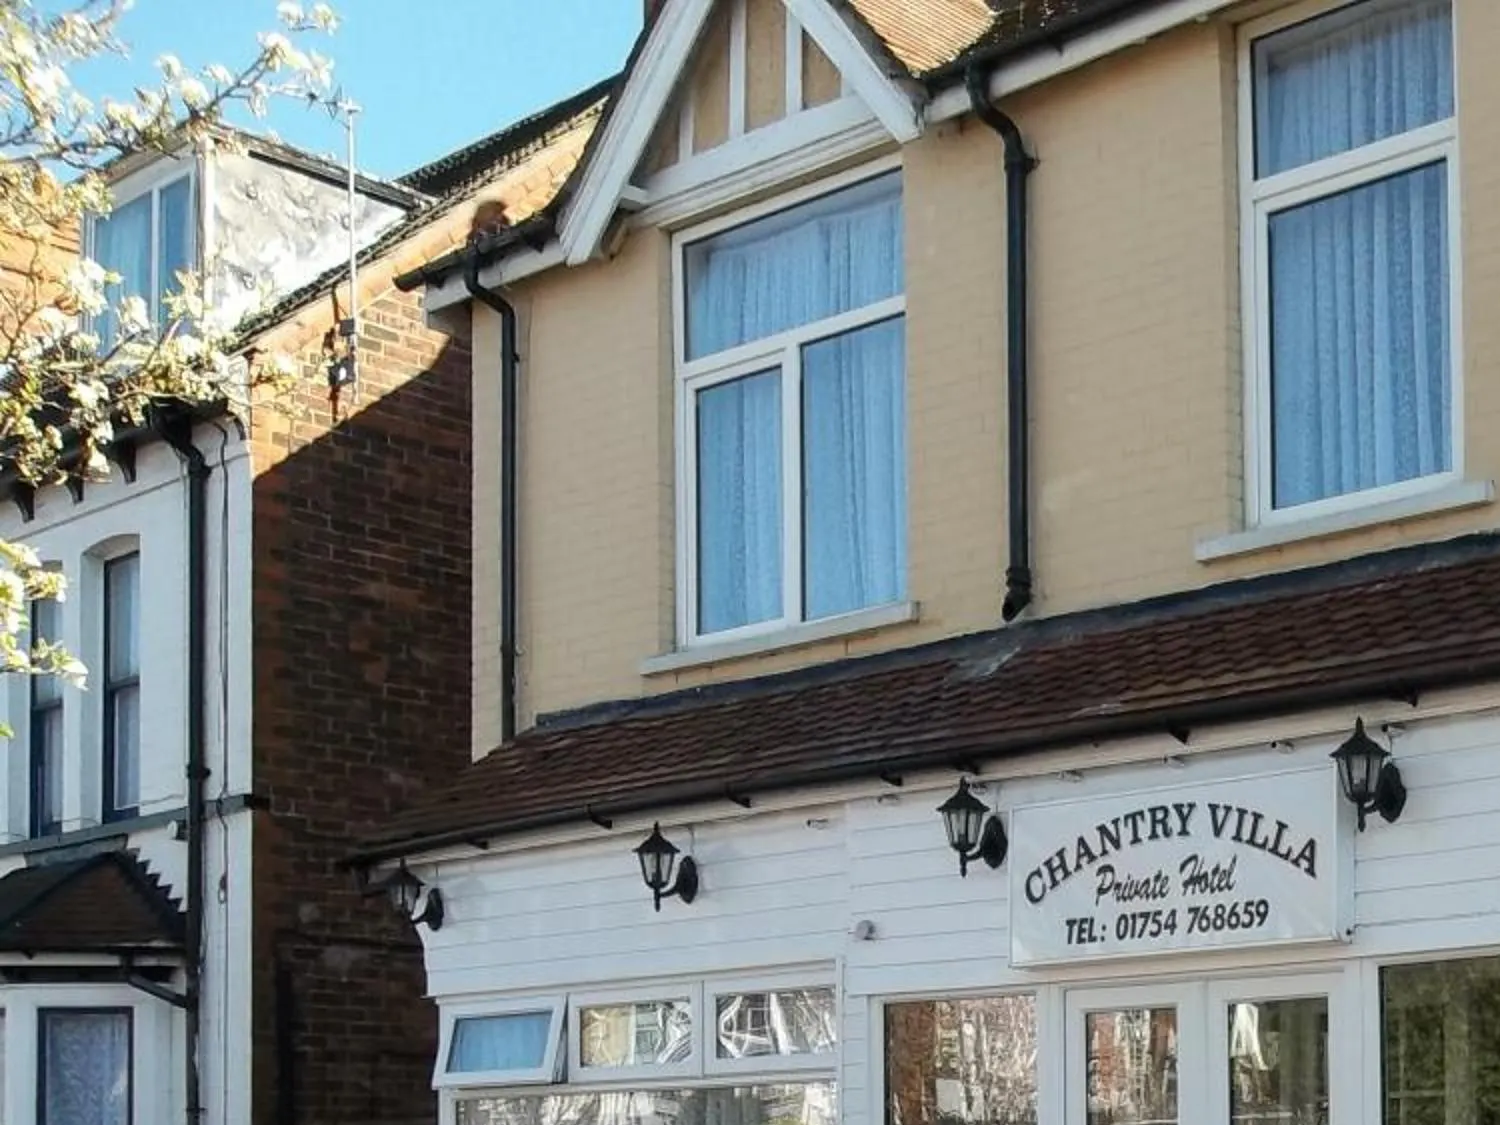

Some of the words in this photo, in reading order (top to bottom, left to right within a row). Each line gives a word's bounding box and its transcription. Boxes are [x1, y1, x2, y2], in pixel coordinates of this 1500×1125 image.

[1025, 802, 1197, 904] CHANTRY
[1207, 803, 1317, 879] VILLA
[1095, 864, 1171, 906] Private
[1179, 853, 1238, 896] Hotel
[1066, 916, 1107, 945] TEL:
[1115, 908, 1178, 940] 01754
[1187, 898, 1270, 934] 768659
